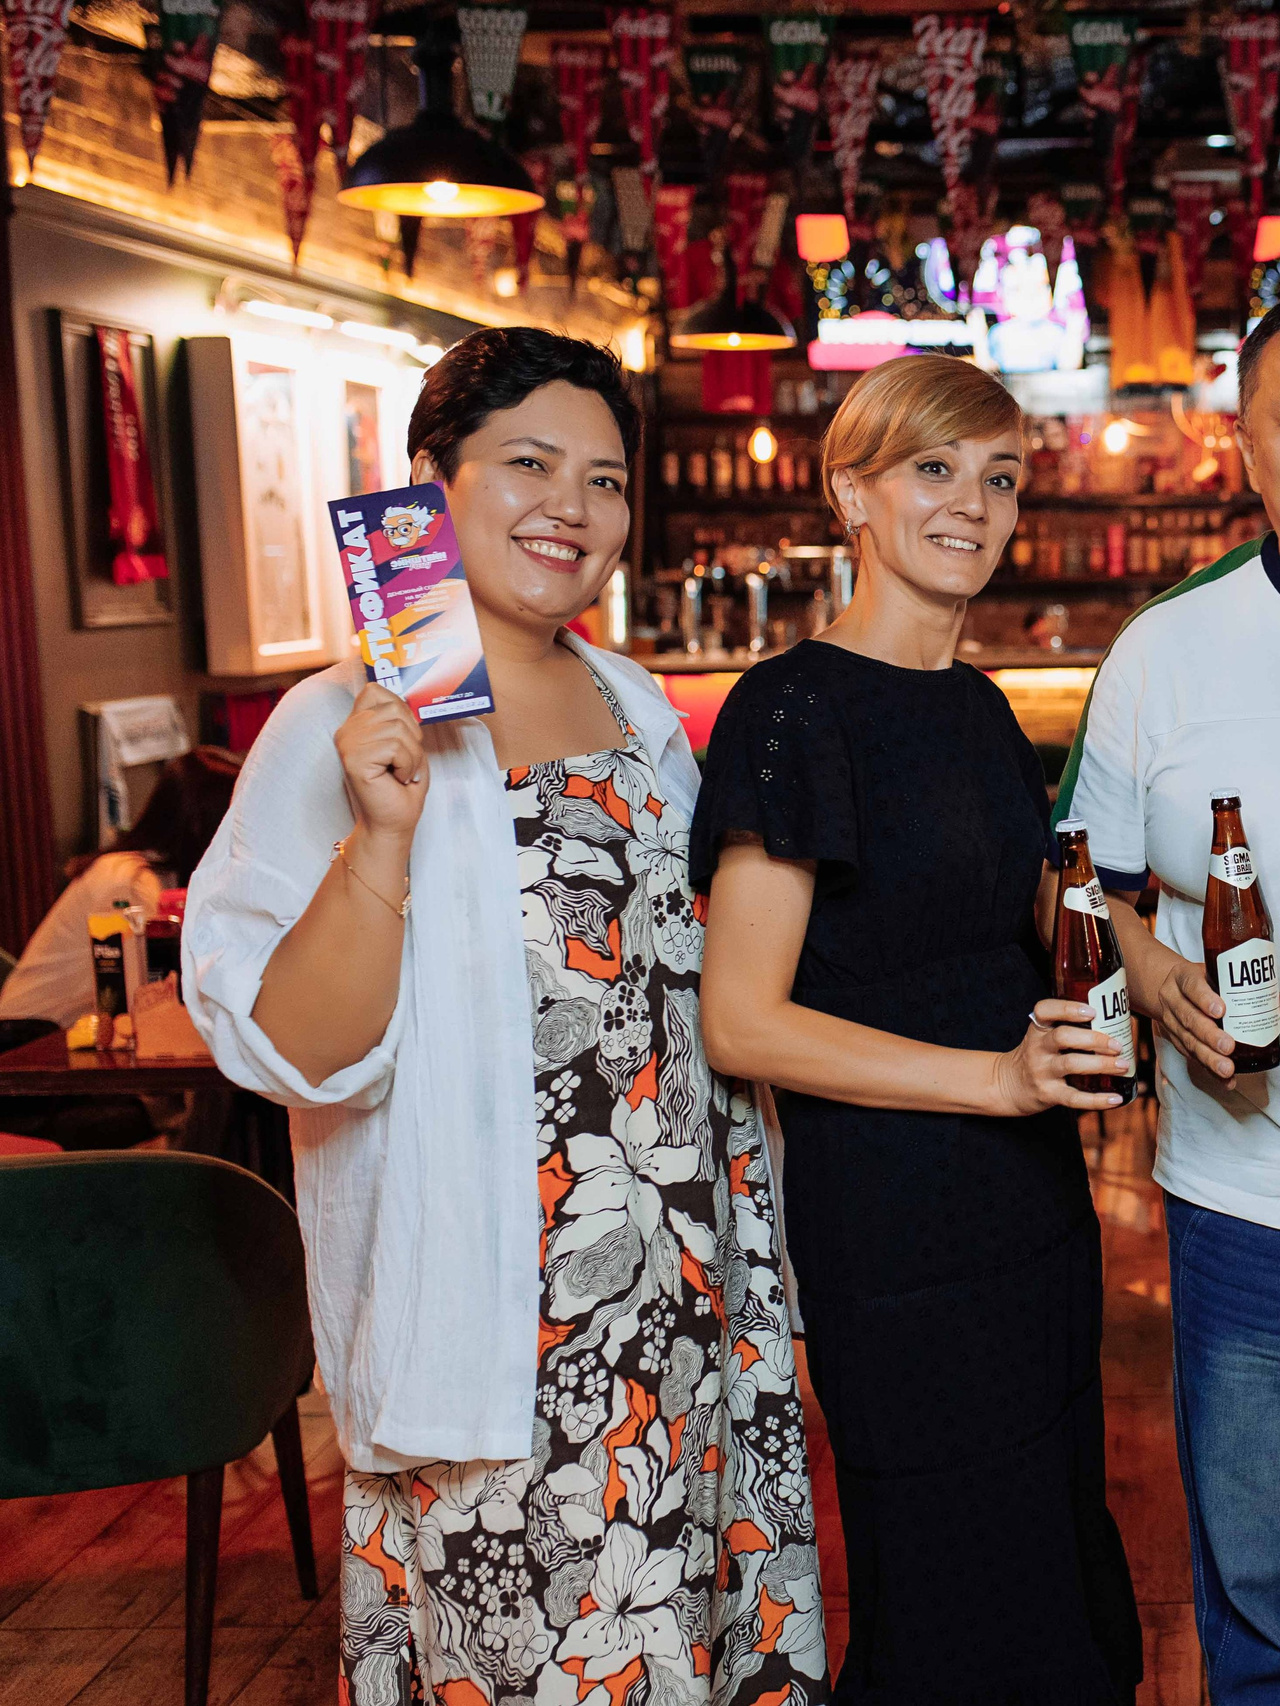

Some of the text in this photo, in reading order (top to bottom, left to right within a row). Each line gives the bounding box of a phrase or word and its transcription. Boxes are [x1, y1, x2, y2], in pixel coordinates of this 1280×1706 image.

[336, 509, 404, 702] ЕРТИФИКАТ
[1223, 852, 1251, 866] SGMA
[1228, 954, 1276, 988] LAGER
